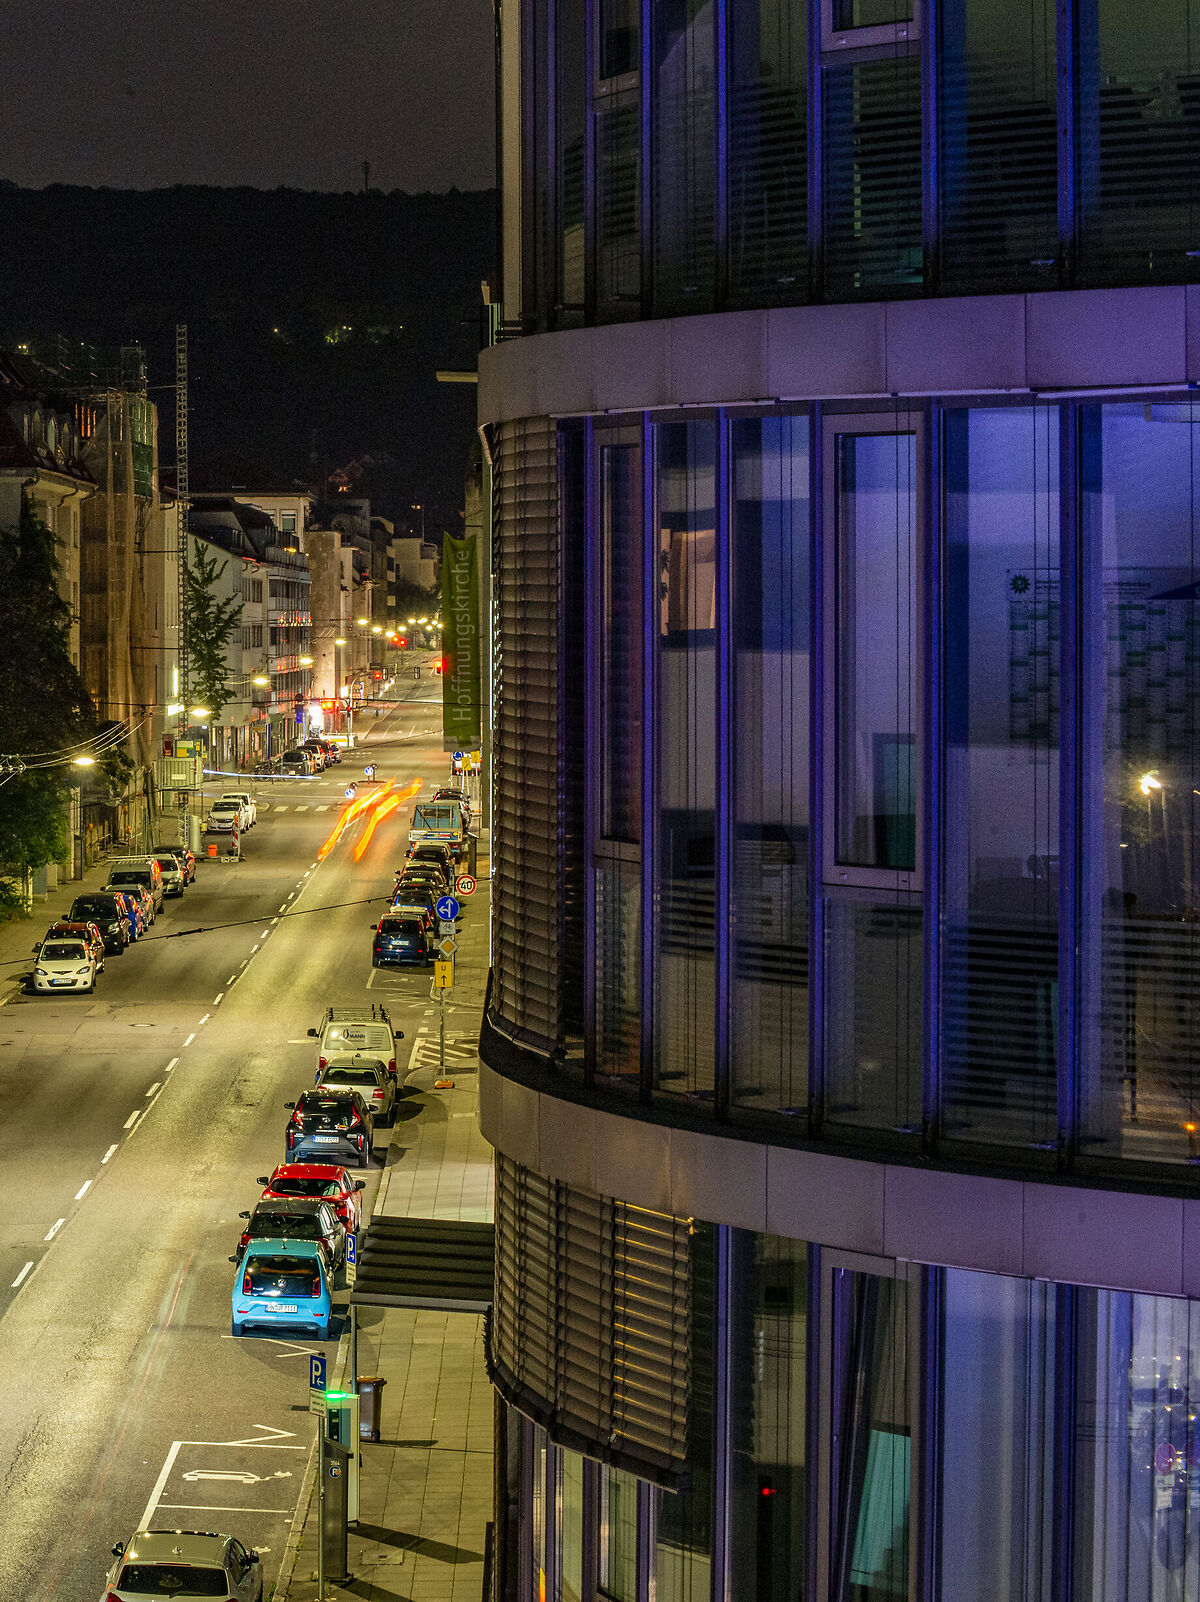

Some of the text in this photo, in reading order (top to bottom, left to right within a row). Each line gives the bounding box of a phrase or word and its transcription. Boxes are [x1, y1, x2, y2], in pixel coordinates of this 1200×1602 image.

[451, 551, 475, 721] Hoffnungskirche
[460, 881, 473, 890] 40
[347, 1237, 354, 1259] P
[312, 1359, 322, 1385] P
